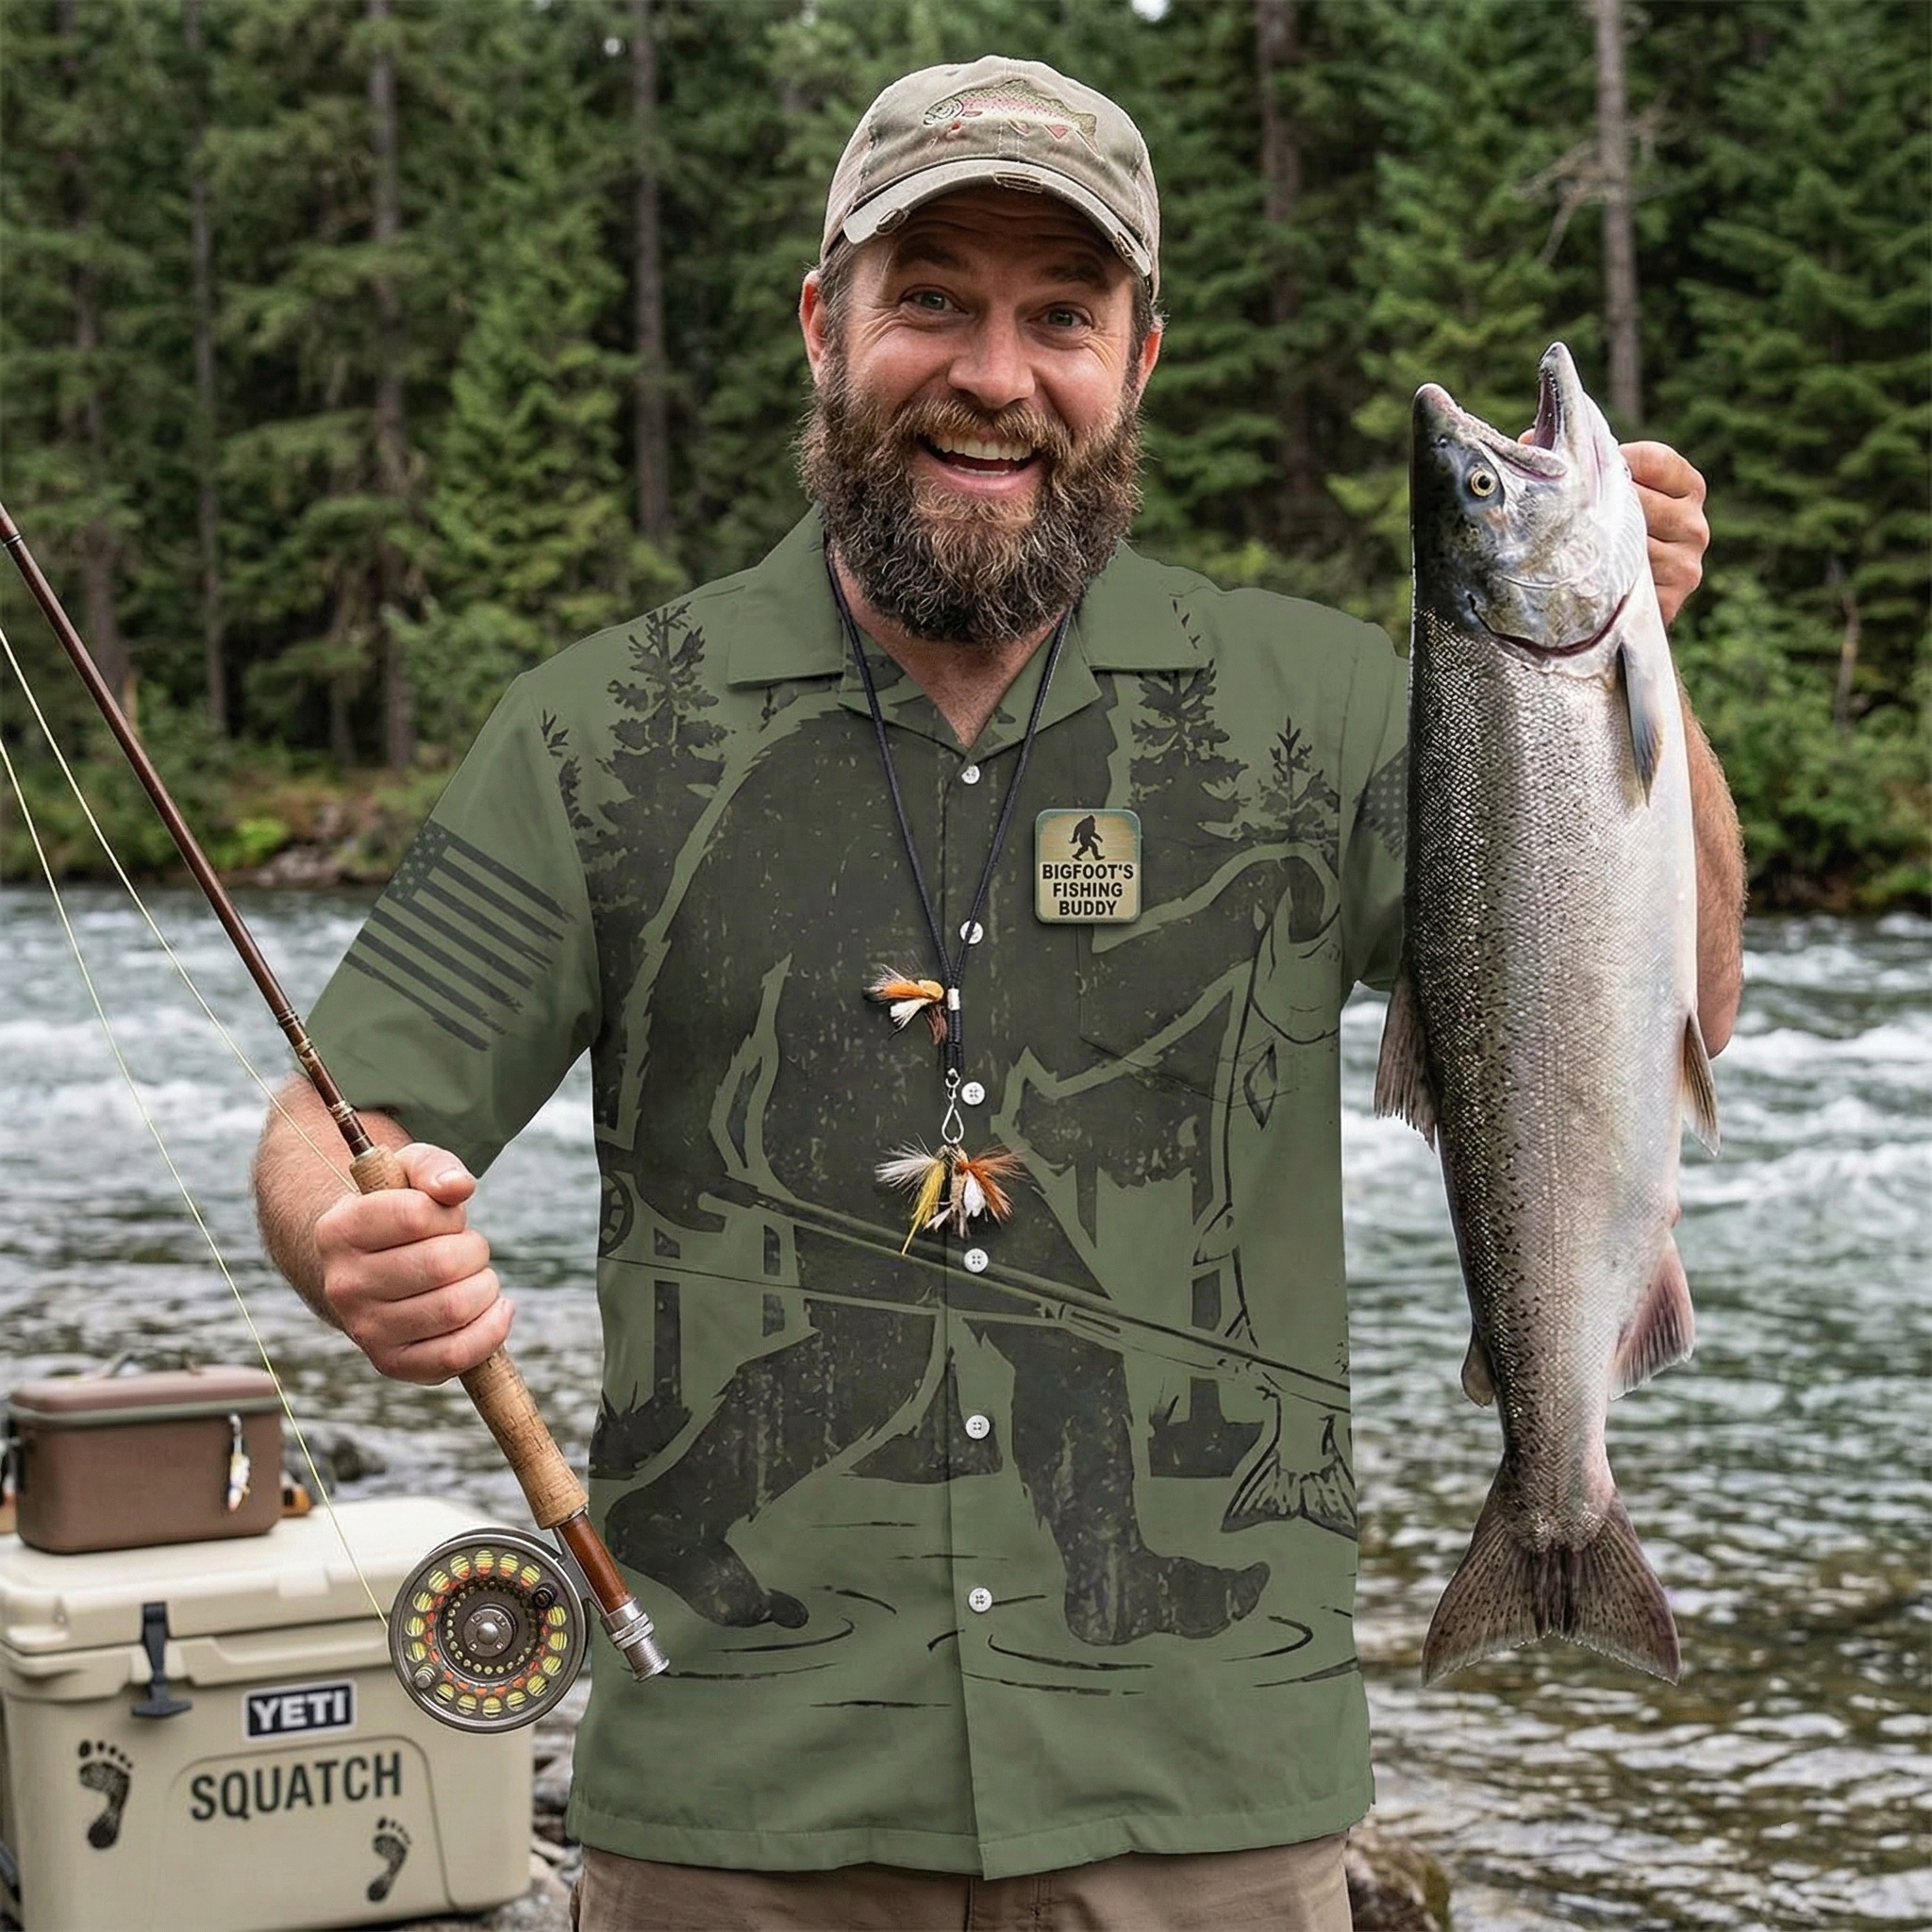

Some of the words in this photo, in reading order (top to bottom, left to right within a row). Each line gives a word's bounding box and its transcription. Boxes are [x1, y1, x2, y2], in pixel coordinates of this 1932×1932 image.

[1042, 864, 1134, 879] BIGFOOT'S
[1053, 882, 1123, 897] FISHING
[1058, 900, 1117, 916] BUDDY
[250, 1690, 347, 1731] YETI
[191, 1751, 401, 1821] SQUATCH
